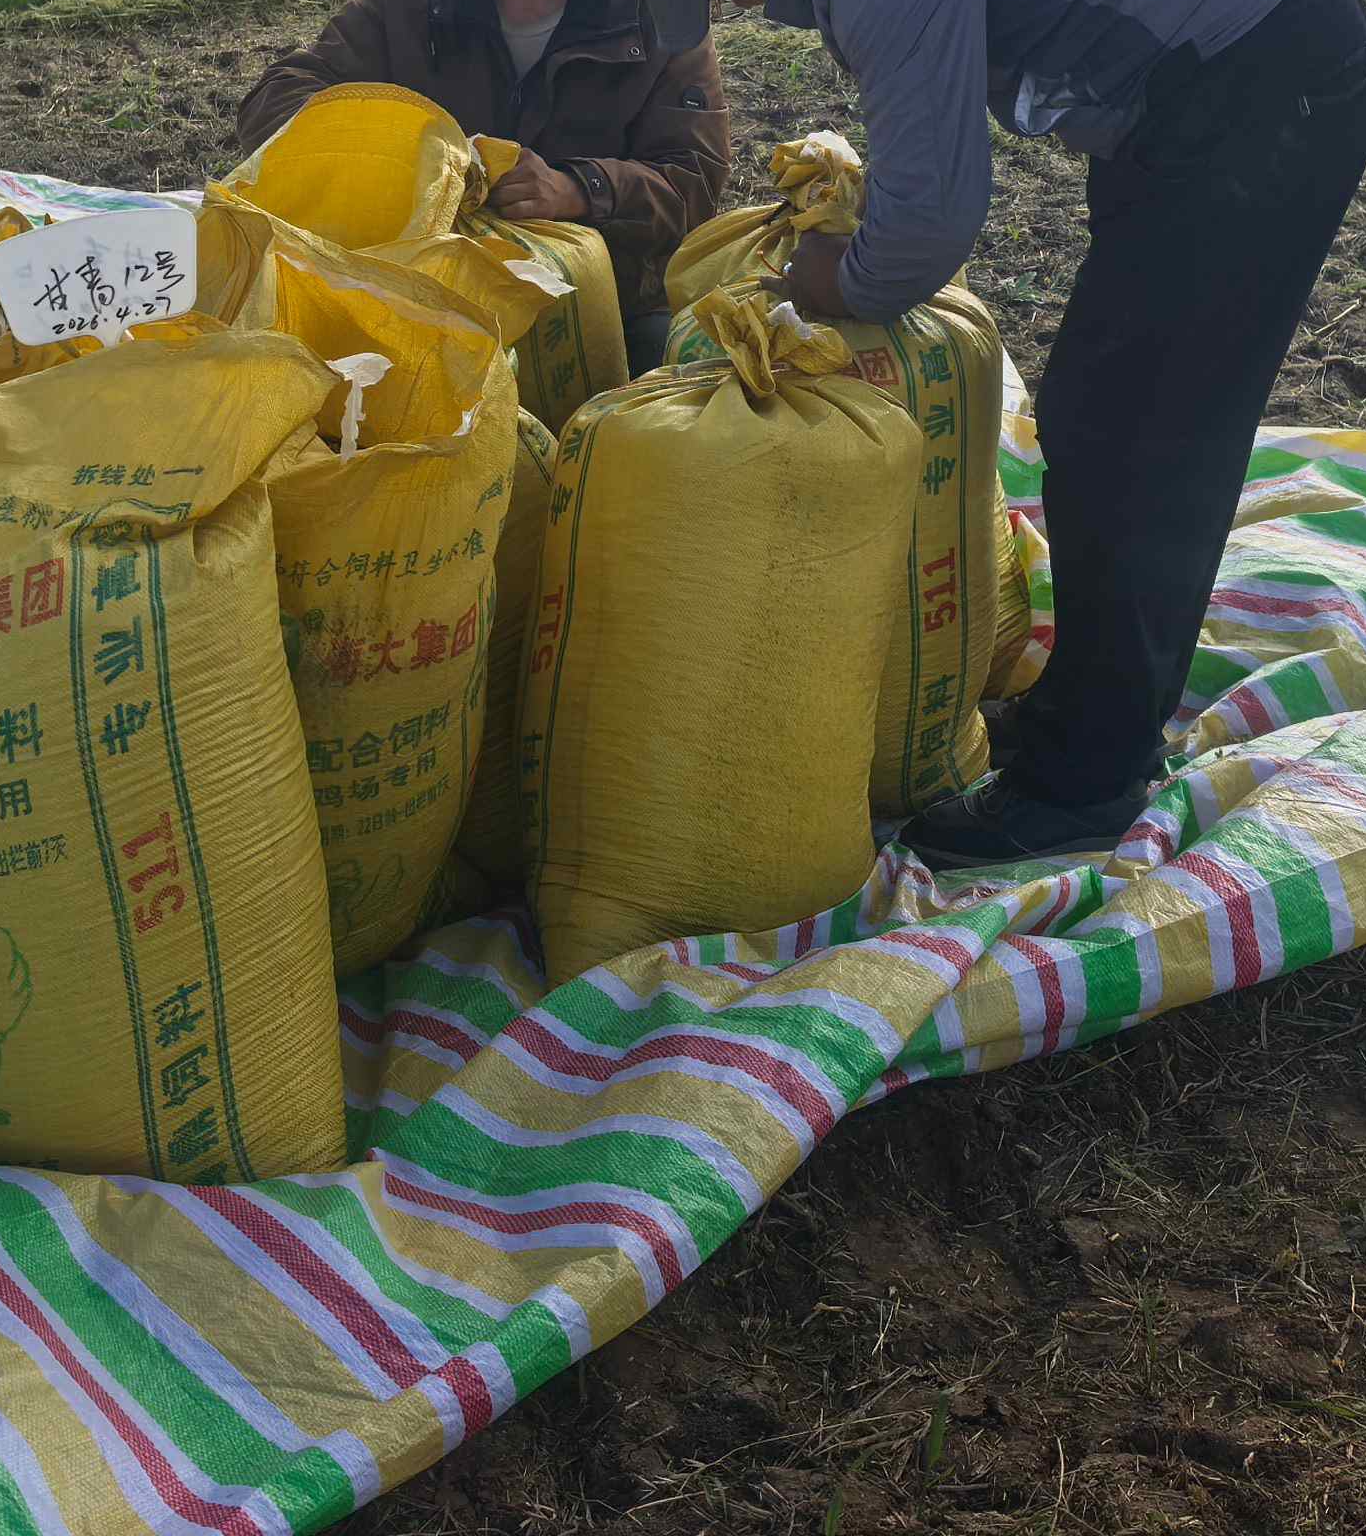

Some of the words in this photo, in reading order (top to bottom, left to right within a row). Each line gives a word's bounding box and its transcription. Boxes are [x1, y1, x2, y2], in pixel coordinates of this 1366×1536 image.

[71, 464, 156, 487] 拆线处
[923, 546, 957, 633] 511
[122, 811, 187, 935] 511
